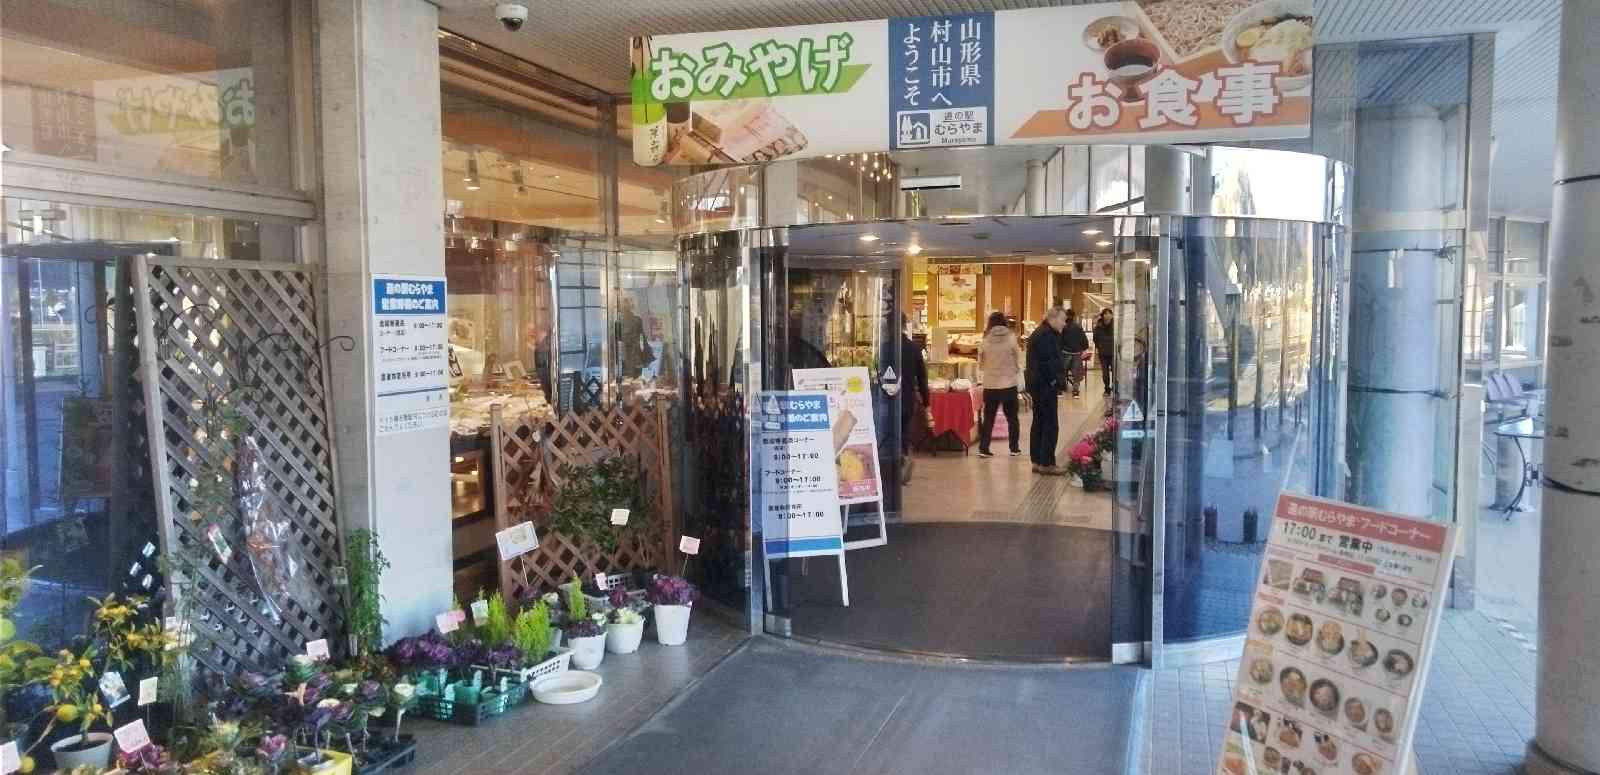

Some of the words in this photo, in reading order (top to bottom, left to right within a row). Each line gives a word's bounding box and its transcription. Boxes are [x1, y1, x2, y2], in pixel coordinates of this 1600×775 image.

[650, 31, 855, 101] おみやげ
[903, 23, 921, 106] ようこそ
[930, 20, 953, 106] 村山市へ
[960, 18, 982, 87] 山形県
[934, 122, 984, 136] むらやま
[944, 111, 975, 121] 道の駅
[1066, 63, 1281, 133] お食事
[1284, 522, 1317, 540] 17:00
[1339, 534, 1373, 554] 営業中
